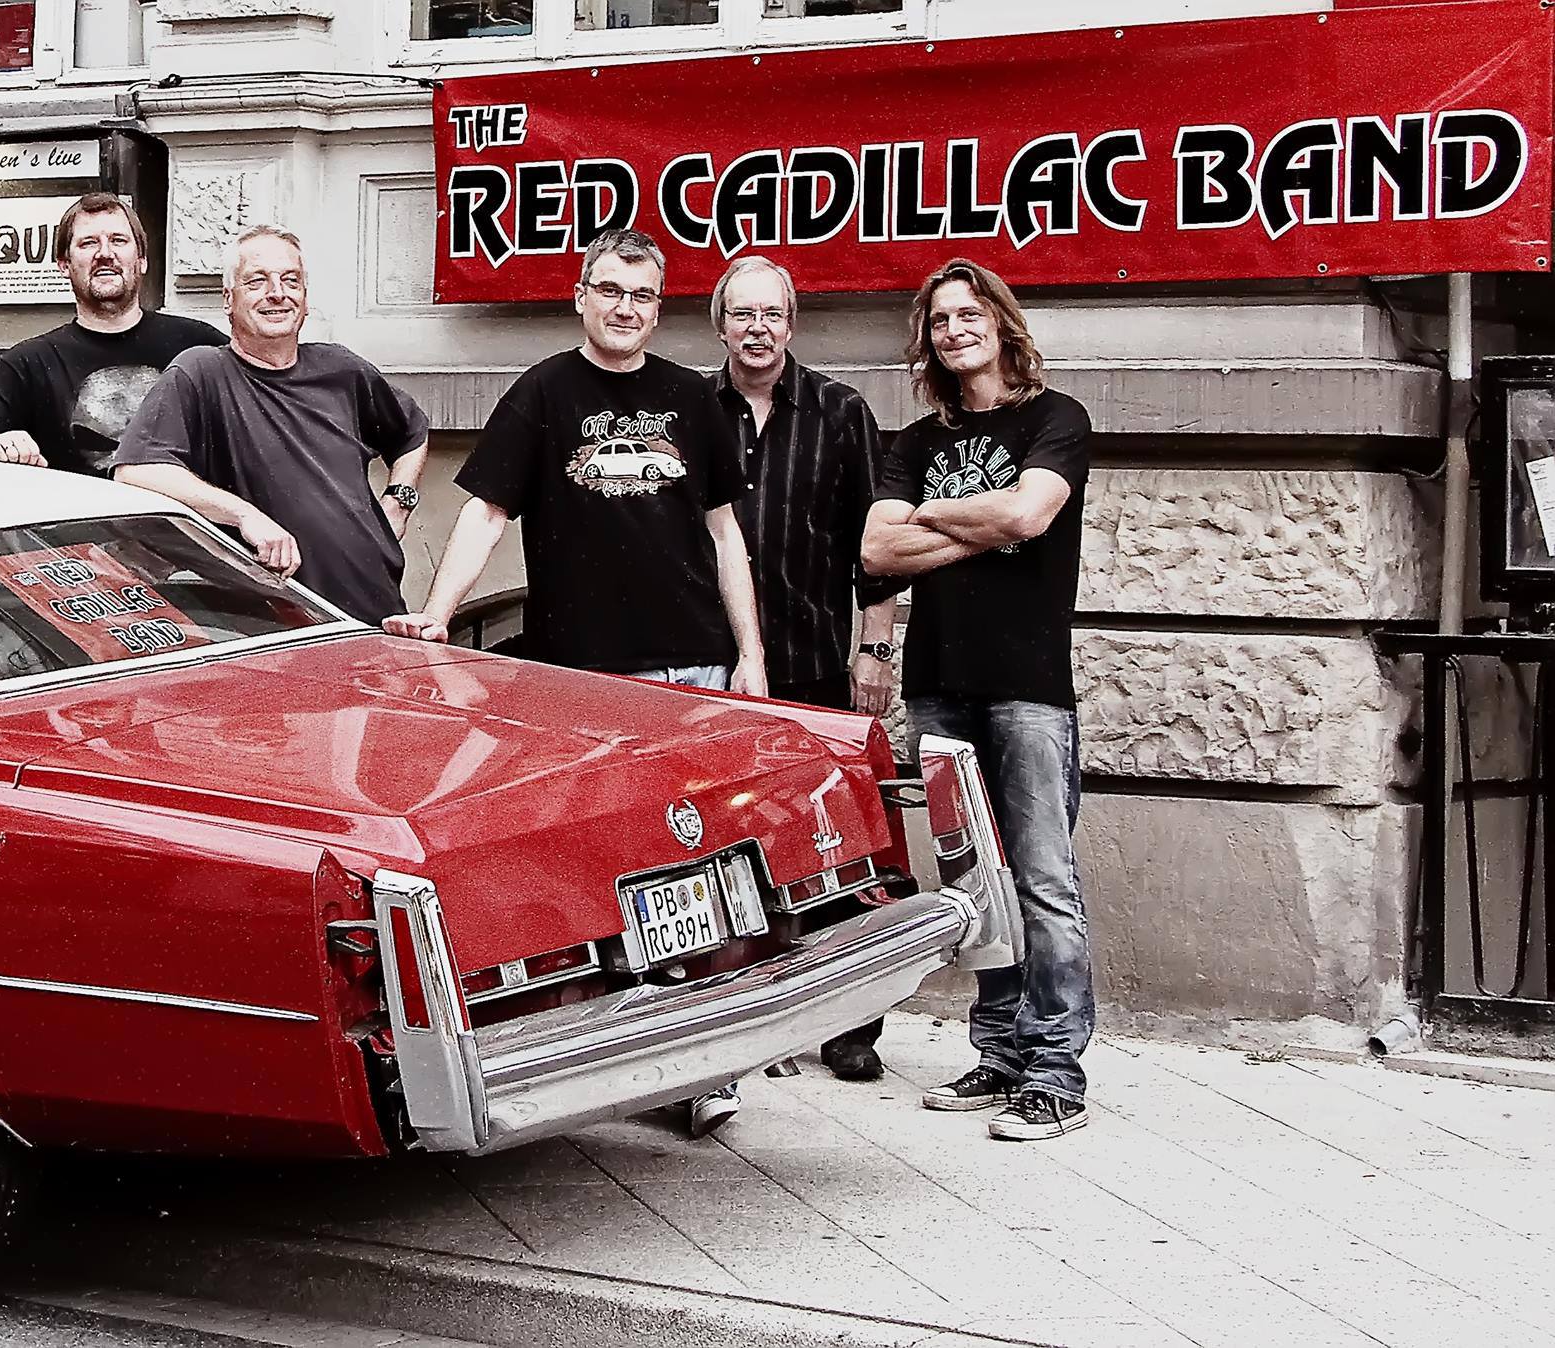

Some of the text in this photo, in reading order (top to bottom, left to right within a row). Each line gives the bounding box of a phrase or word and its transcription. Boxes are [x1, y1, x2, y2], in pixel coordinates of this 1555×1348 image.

[448, 103, 528, 152] THE
[47, 147, 83, 169] live
[448, 109, 1529, 269] RED CADILLAC BAND
[614, 410, 678, 441] School
[923, 451, 949, 500] URF
[985, 445, 1020, 489] WA
[35, 558, 95, 587] RED
[50, 585, 166, 624] CADILLAC
[108, 618, 186, 654] BAND
[652, 887, 678, 920] PB
[647, 923, 673, 959] RC
